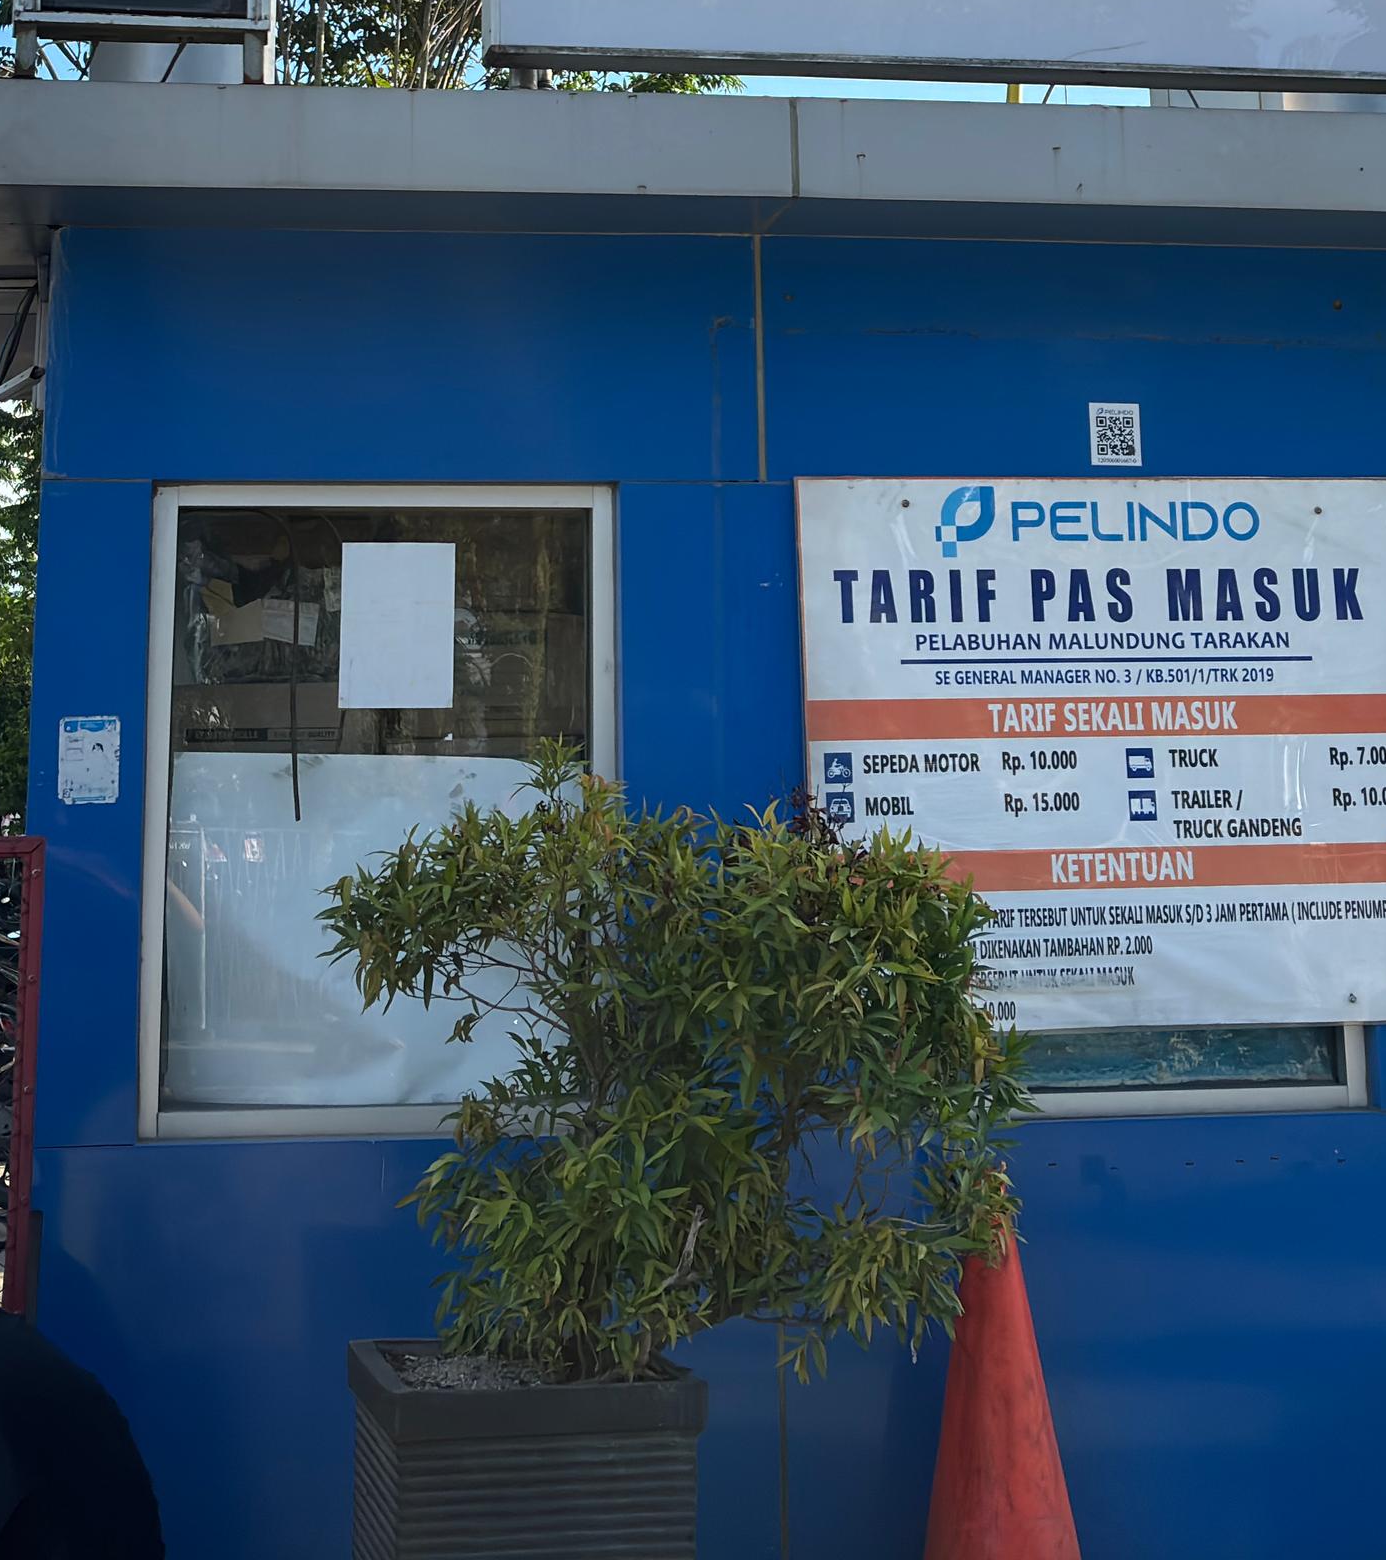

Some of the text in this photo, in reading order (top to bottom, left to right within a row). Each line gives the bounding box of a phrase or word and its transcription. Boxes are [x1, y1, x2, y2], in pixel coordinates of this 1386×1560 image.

[1010, 501, 1260, 542] PELINDO
[832, 566, 1365, 624] TARIF PAS MASUK
[915, 631, 1291, 652] PELABUHAN MALUNDUNG TARAKAN
[935, 666, 1275, 686] SE GENERAL MANAGER NO. 3 / KB.501/1/TRK 2019
[988, 701, 1238, 733] TARIF SEKALI MASUK
[863, 754, 920, 775] SEPEDA
[924, 753, 981, 773] MOTOR
[1002, 752, 1026, 776] Rp.
[1029, 750, 1078, 771] 10.000
[1169, 748, 1220, 769] TRUCK
[1329, 747, 1354, 771] Rp.
[865, 796, 915, 817] MOBIL
[1004, 793, 1028, 818] Rp.
[1032, 792, 1081, 812] 15.000
[1171, 790, 1234, 810] TRAILER
[1236, 789, 1244, 811] /
[1332, 787, 1357, 812] Rp.
[1173, 817, 1303, 840] TRUCK GANDENG
[1050, 850, 1195, 885] KETENTUAN
[1017, 906, 1068, 928] TERSEBUT
[1070, 905, 1107, 927] UNTUK
[1108, 905, 1144, 926] SEKALI
[1145, 904, 1184, 925] MASUK
[1186, 903, 1204, 926] S/D
[1206, 903, 1213, 924] 3
[1215, 903, 1237, 924] JAM
[1240, 901, 1290, 923] PERTAMA
[979, 938, 1042, 960] DIKENAKAN
[1043, 936, 1105, 958] TAMBAHAN
[1107, 935, 1124, 956] RP.
[1126, 934, 1153, 955] 2.000
